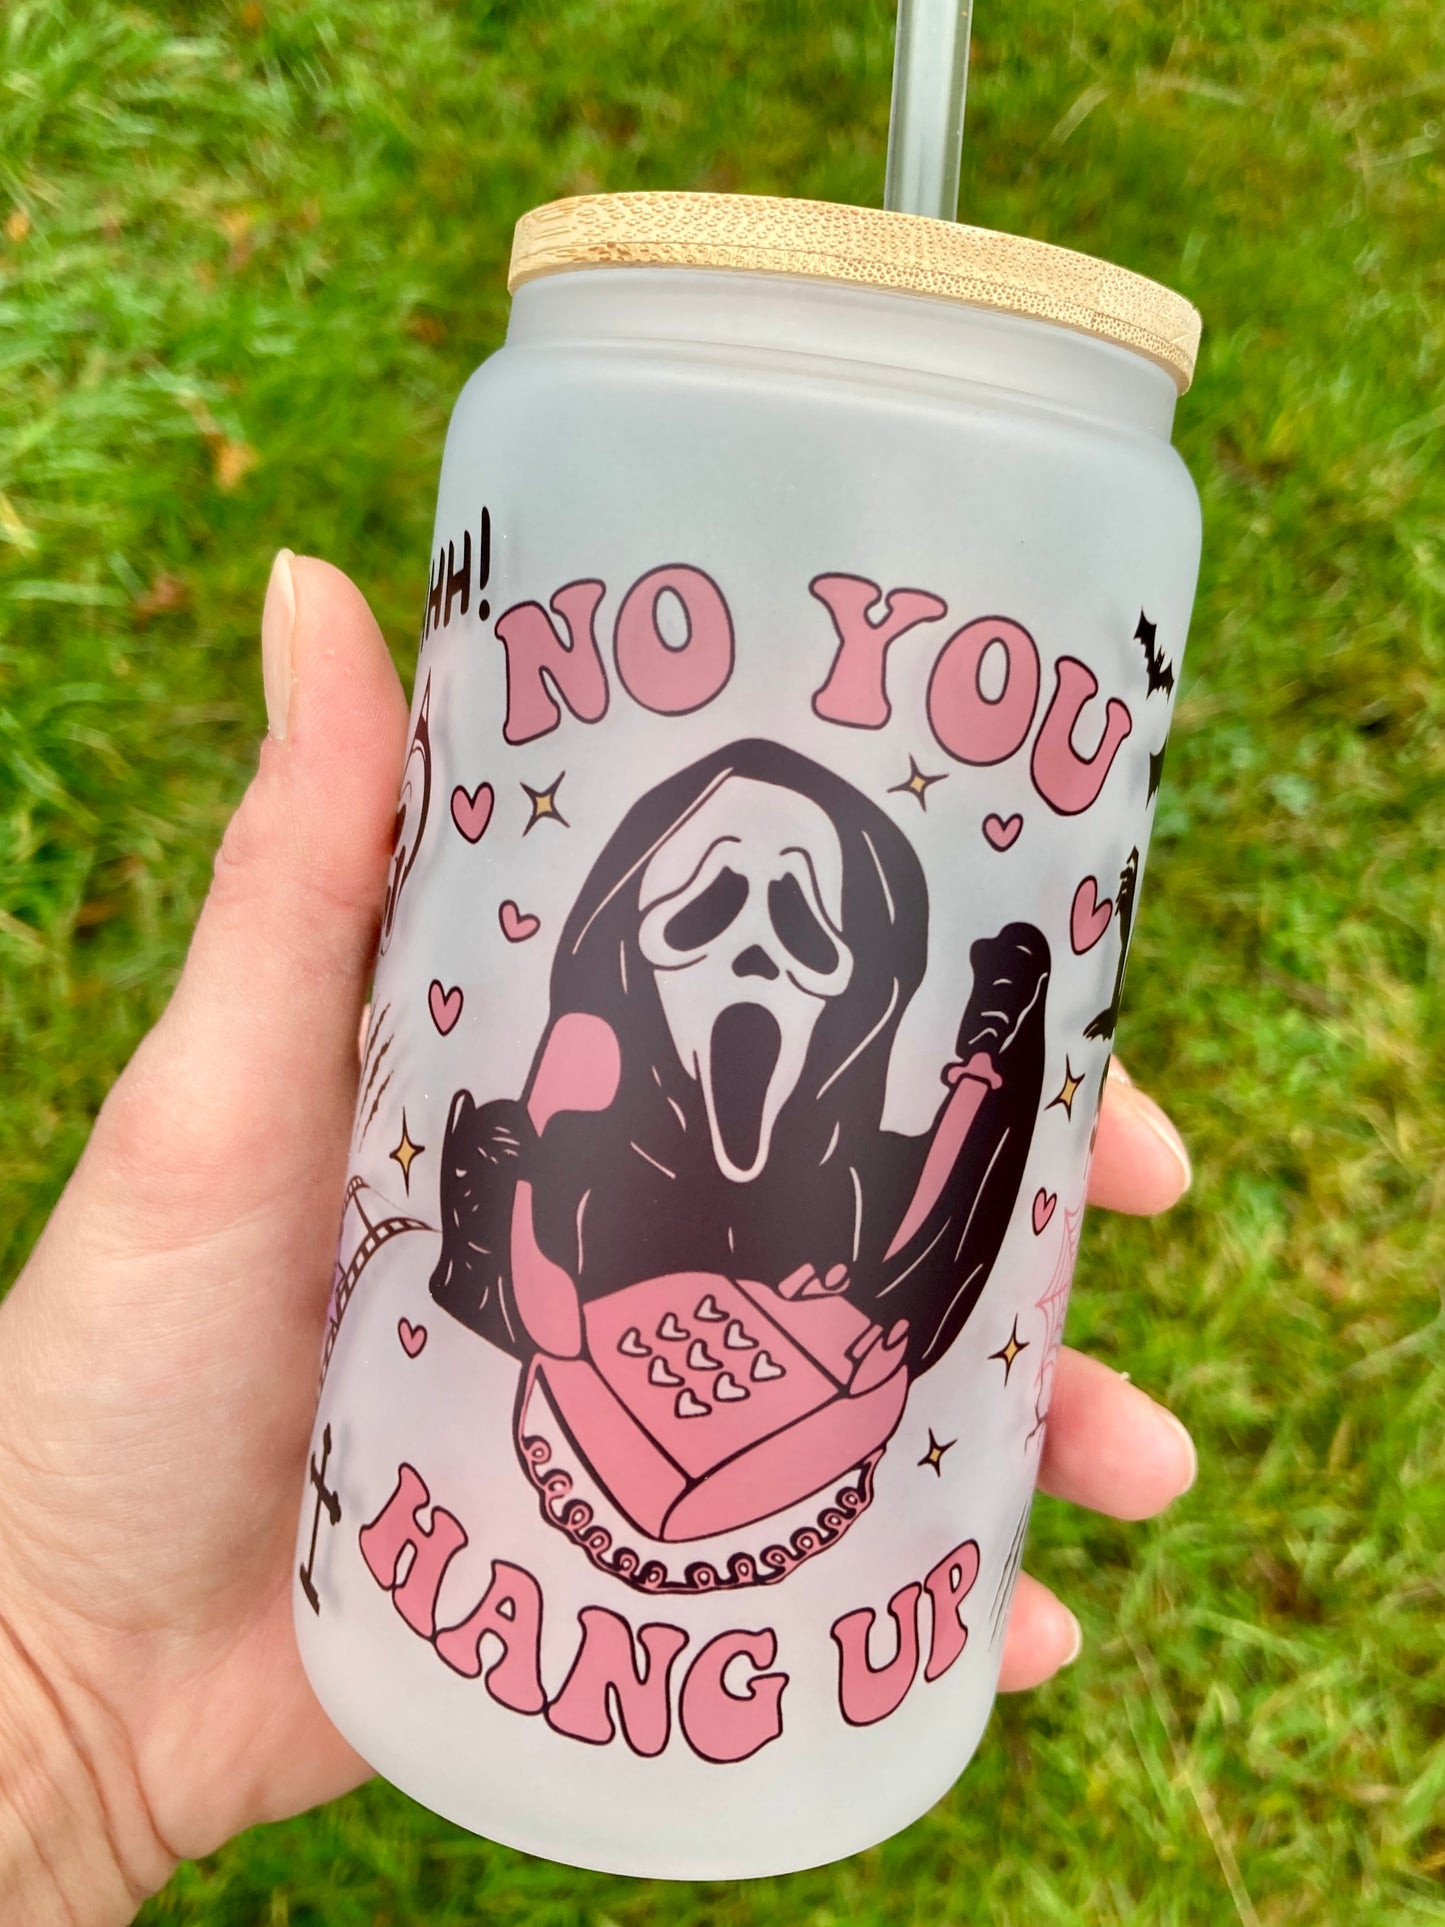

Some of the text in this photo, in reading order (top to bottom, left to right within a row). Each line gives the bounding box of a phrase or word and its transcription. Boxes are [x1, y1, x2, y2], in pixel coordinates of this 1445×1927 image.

[420, 506, 491, 653] HH!
[495, 563, 1132, 816] NO YOU
[359, 1462, 981, 1764] HANG UP
